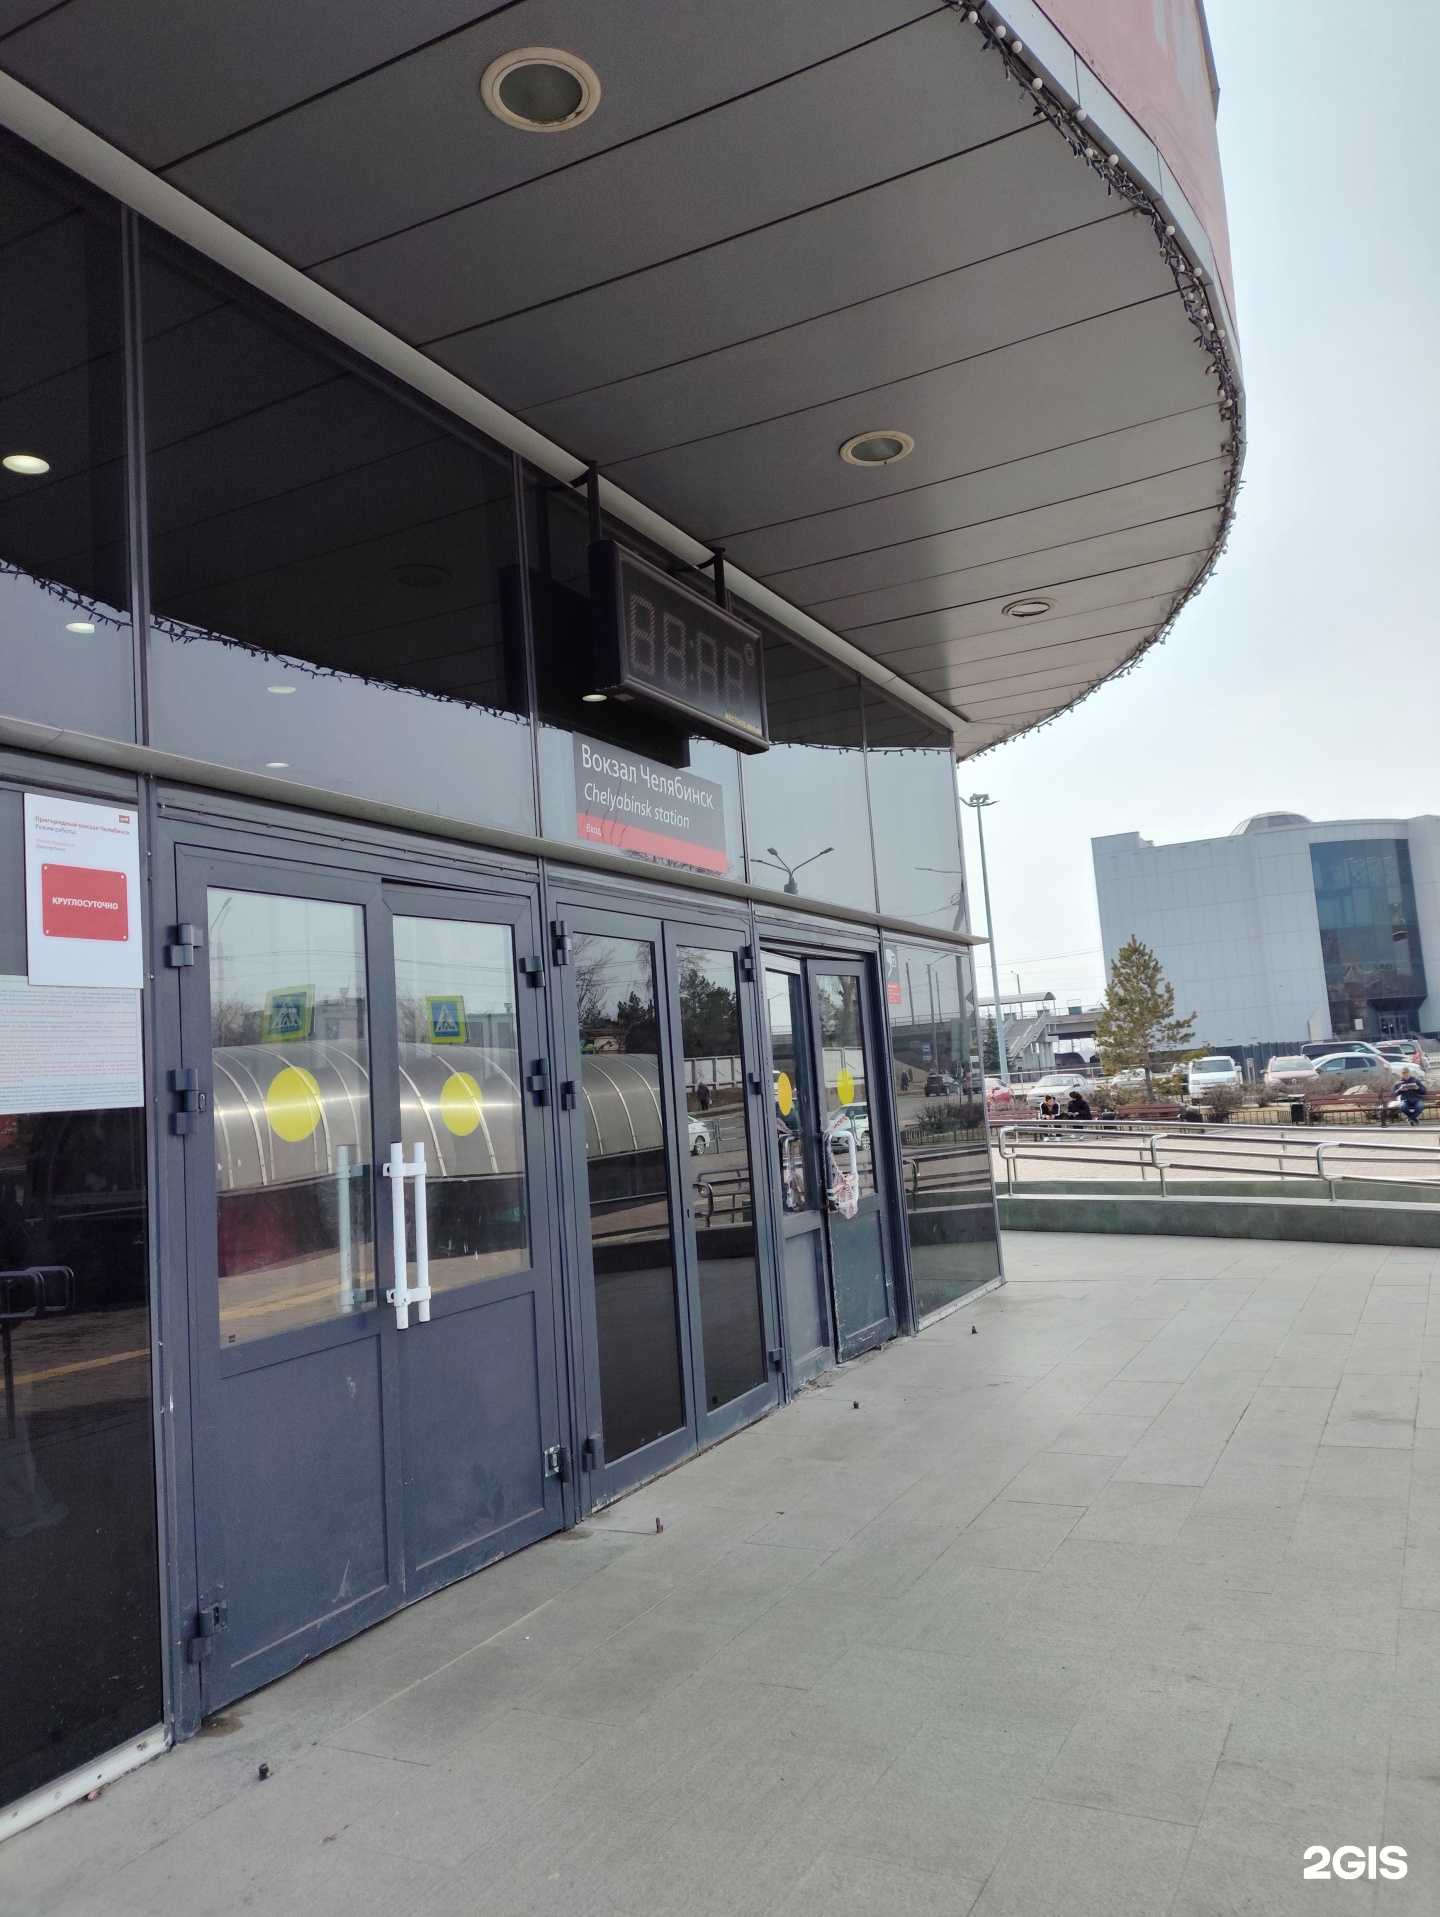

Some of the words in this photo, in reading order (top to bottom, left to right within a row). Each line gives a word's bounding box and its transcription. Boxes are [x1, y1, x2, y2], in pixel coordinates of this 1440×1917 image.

[581, 743, 637, 784] Вокзал
[640, 764, 715, 810] Челябинск
[584, 782, 652, 818] Chelyabinsk
[654, 806, 690, 829] station
[52, 896, 119, 911] КРУГЛОСУТОЧНО
